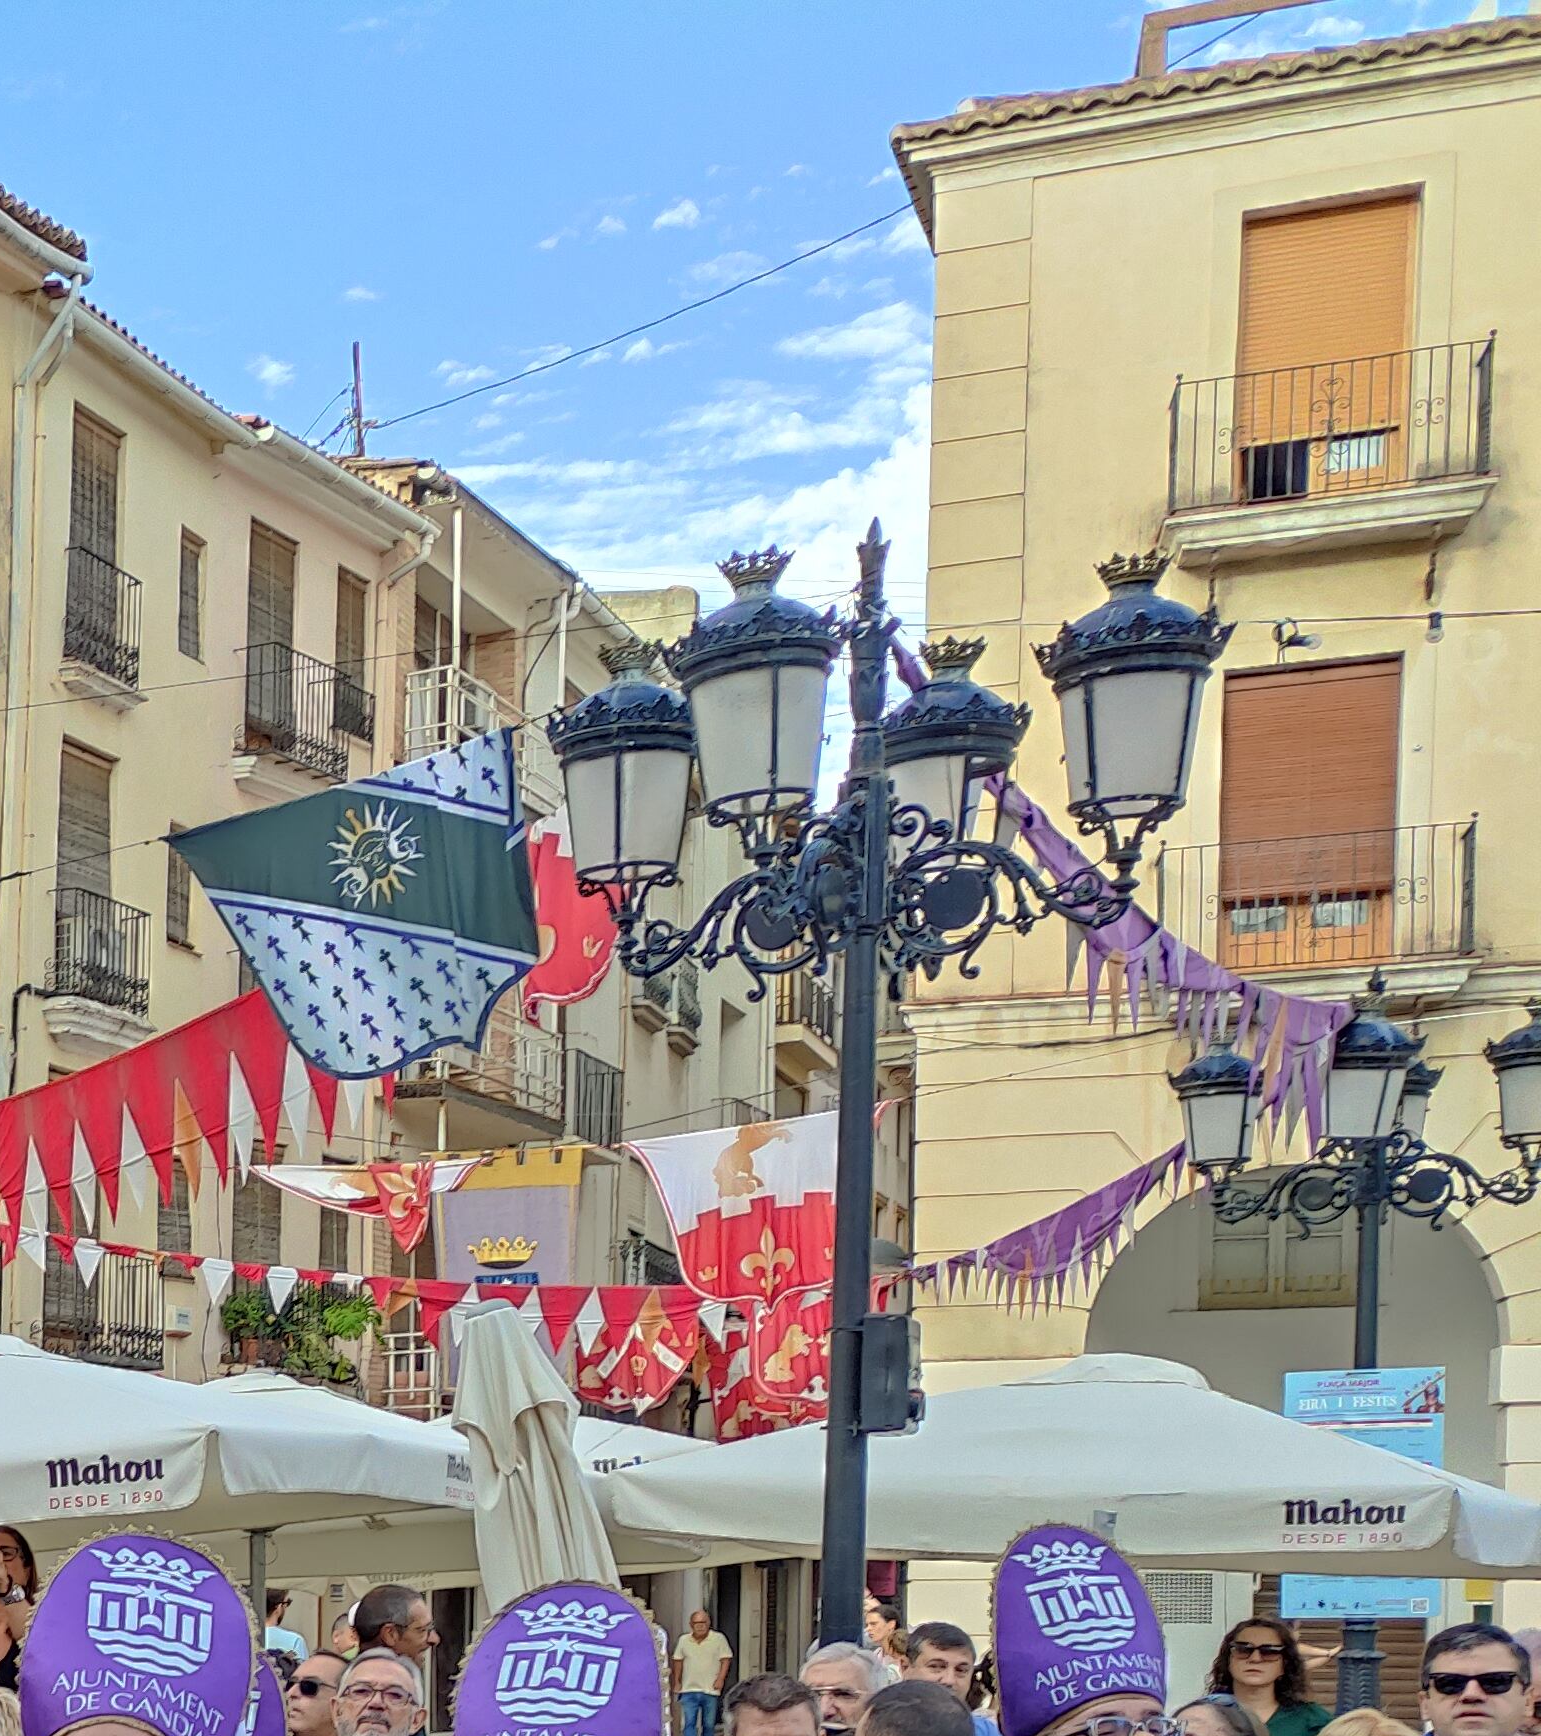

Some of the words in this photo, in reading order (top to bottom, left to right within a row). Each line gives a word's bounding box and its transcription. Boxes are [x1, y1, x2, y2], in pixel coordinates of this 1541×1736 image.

[45, 1454, 164, 1488] Mahou
[49, 1493, 110, 1509] DESDE
[120, 1489, 164, 1505] 1890
[1282, 1498, 1407, 1525] Mahou
[1282, 1533, 1348, 1544] DESDE
[1358, 1532, 1403, 1544] 1890
[1035, 1654, 1163, 1691] AJUNTAMENT
[1050, 1683, 1081, 1707] DE
[1086, 1667, 1163, 1692] GANDIA
[52, 1669, 225, 1734] AJUNTAMENT
[66, 1692, 101, 1717] DE
